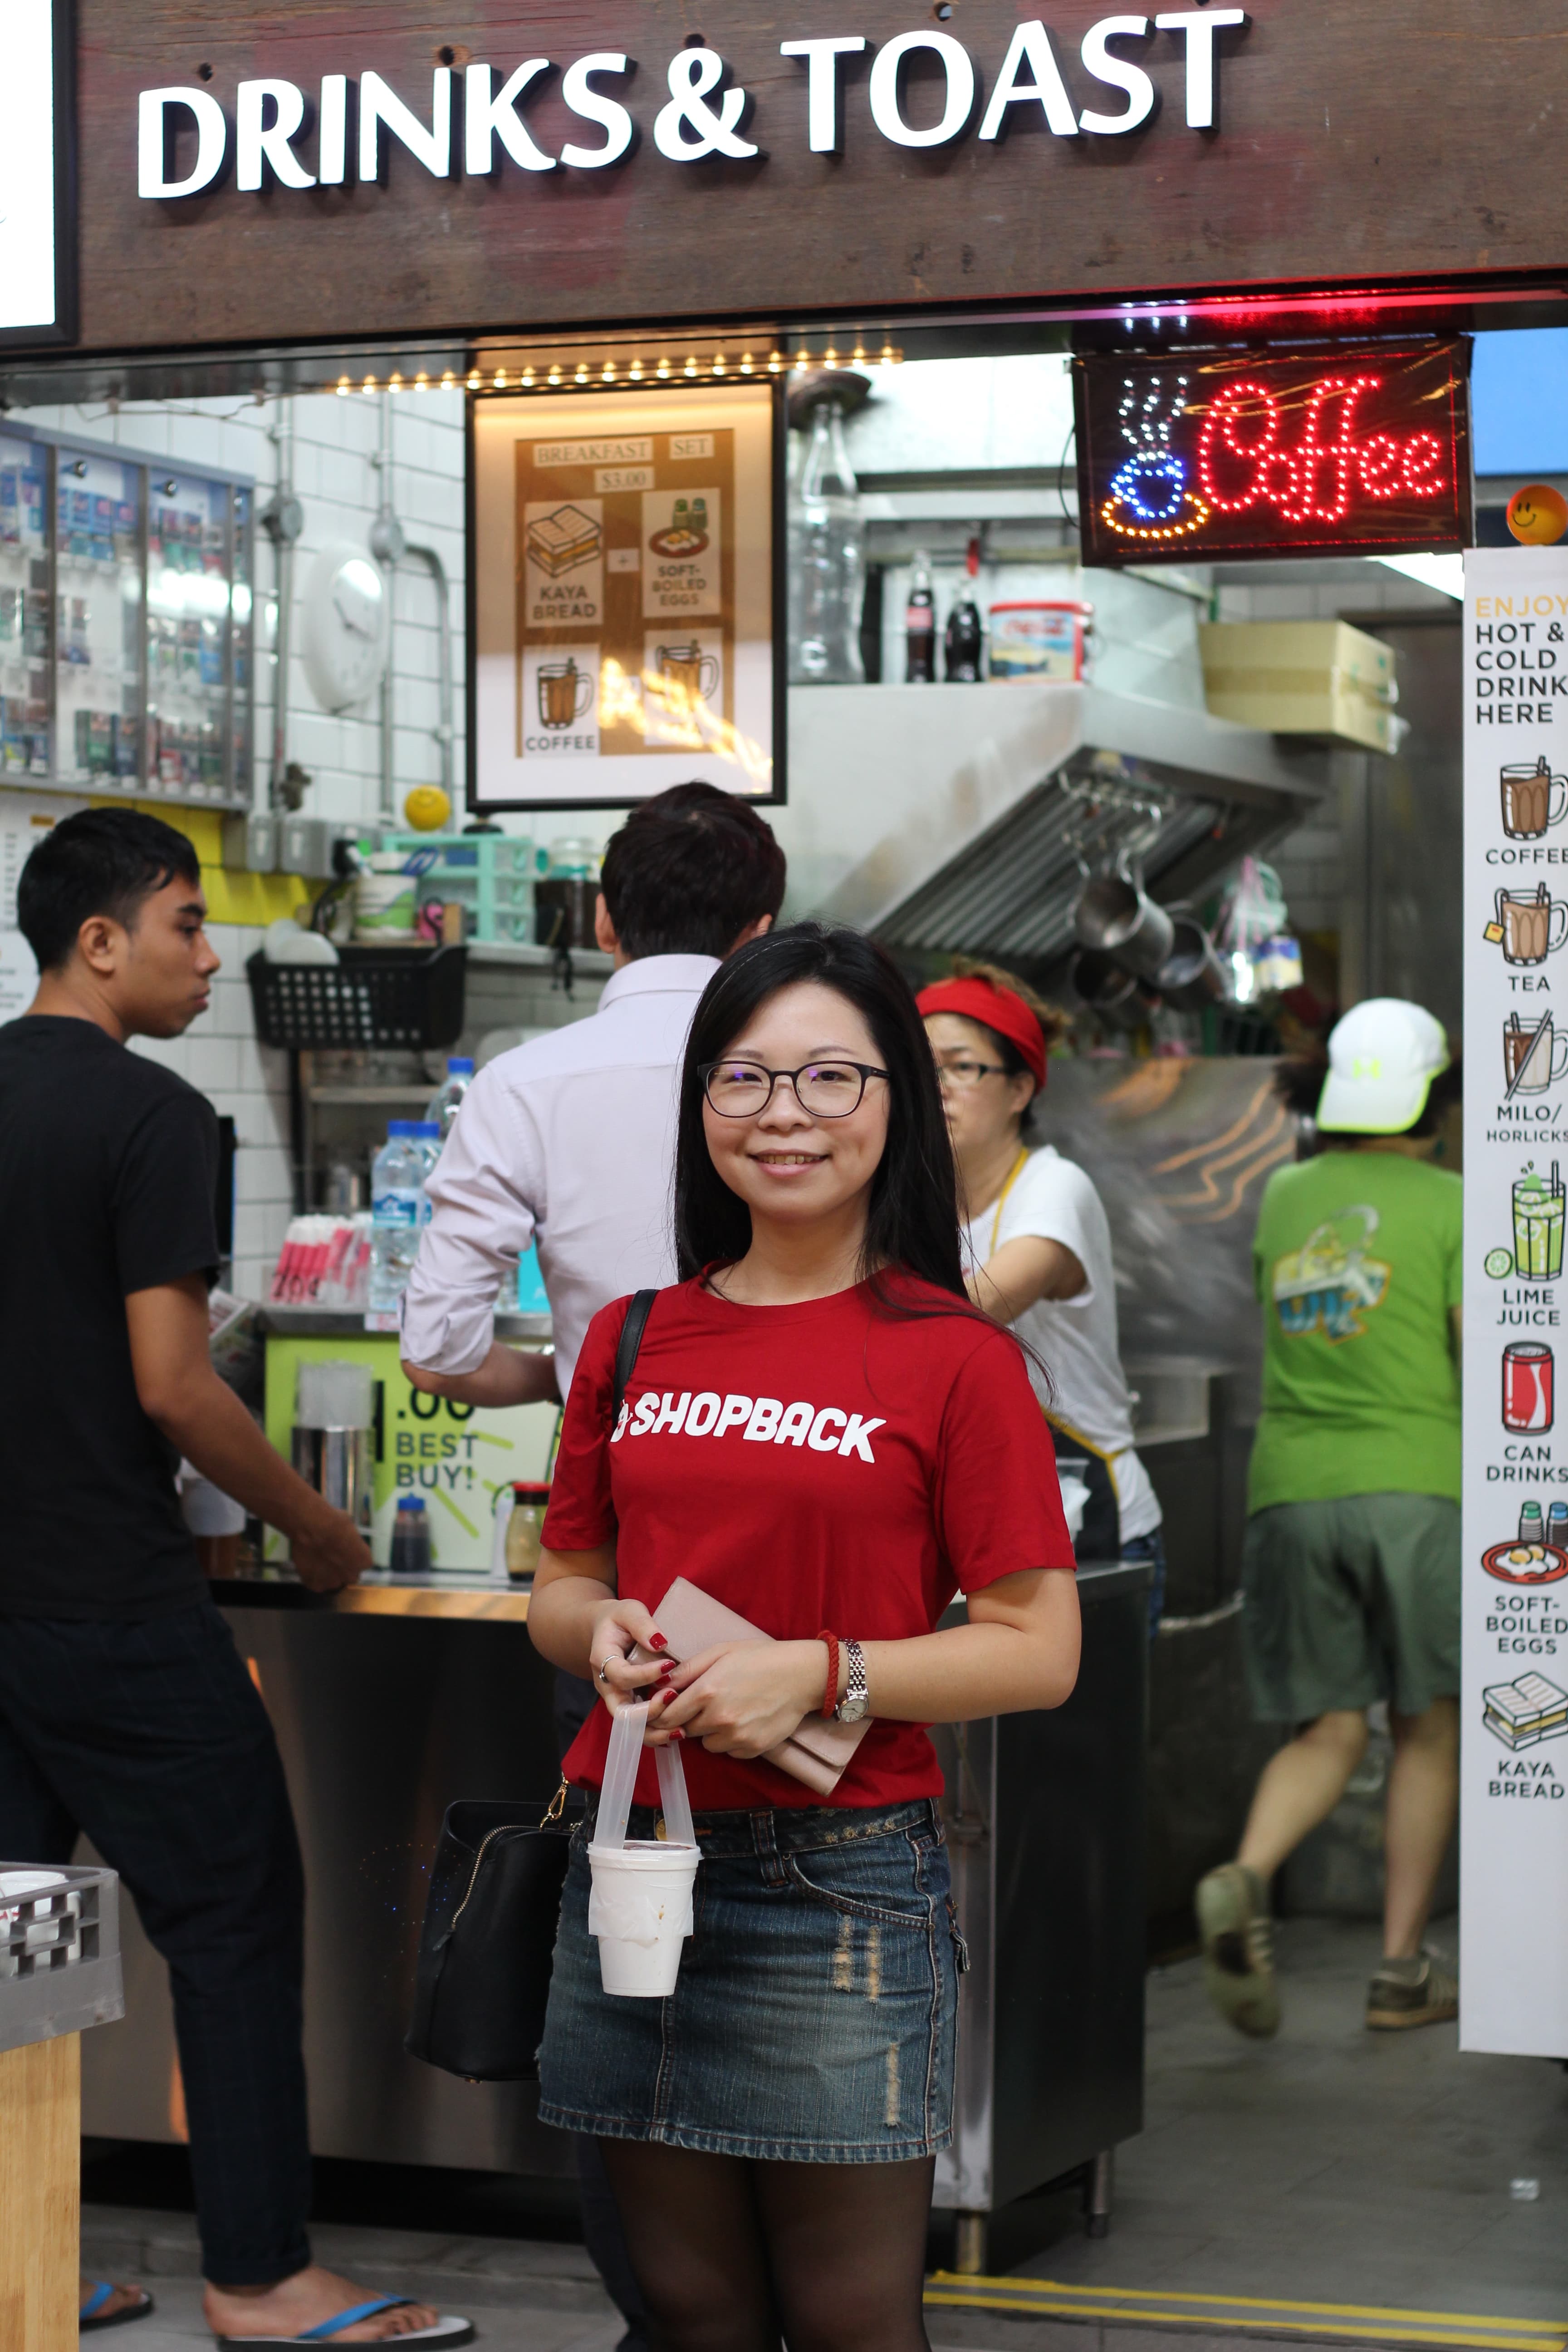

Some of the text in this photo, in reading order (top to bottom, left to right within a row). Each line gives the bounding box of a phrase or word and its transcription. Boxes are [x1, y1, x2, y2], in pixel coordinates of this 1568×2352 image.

[138, 9, 1245, 199] DRINKS & TOAST
[537, 438, 708, 464] BREAKFAST SET
[1197, 376, 1444, 521] Coffee
[602, 470, 647, 489] $3.00
[658, 564, 701, 578] SOFT-
[539, 585, 588, 602] KAYA
[652, 578, 707, 592] BOILED
[660, 593, 699, 607] EGGS
[1476, 595, 1568, 617] ENJOY
[533, 603, 597, 621] BREAD
[1476, 621, 1564, 644] HOT &
[1475, 649, 1557, 671] COLD
[1476, 702, 1553, 725] HERE
[525, 735, 596, 751] COFFEE
[1508, 975, 1551, 992] TEA
[1497, 1103, 1562, 1124] MILO/
[1503, 1289, 1554, 1305] LIME
[1496, 1309, 1560, 1326] JUICE
[629, 1392, 887, 1464] SHOPBACK
[396, 1432, 479, 1458] BEST
[1504, 1445, 1552, 1462] CAN
[396, 1463, 473, 1490] BUY!
[1486, 1465, 1568, 1483] DRINKS
[1495, 1594, 1560, 1612] SOFT-
[1486, 1616, 1568, 1634] BOILED
[1498, 1637, 1557, 1655] EGGS
[1498, 1760, 1555, 1778] KAYA
[1489, 1780, 1565, 1799] BREAD
